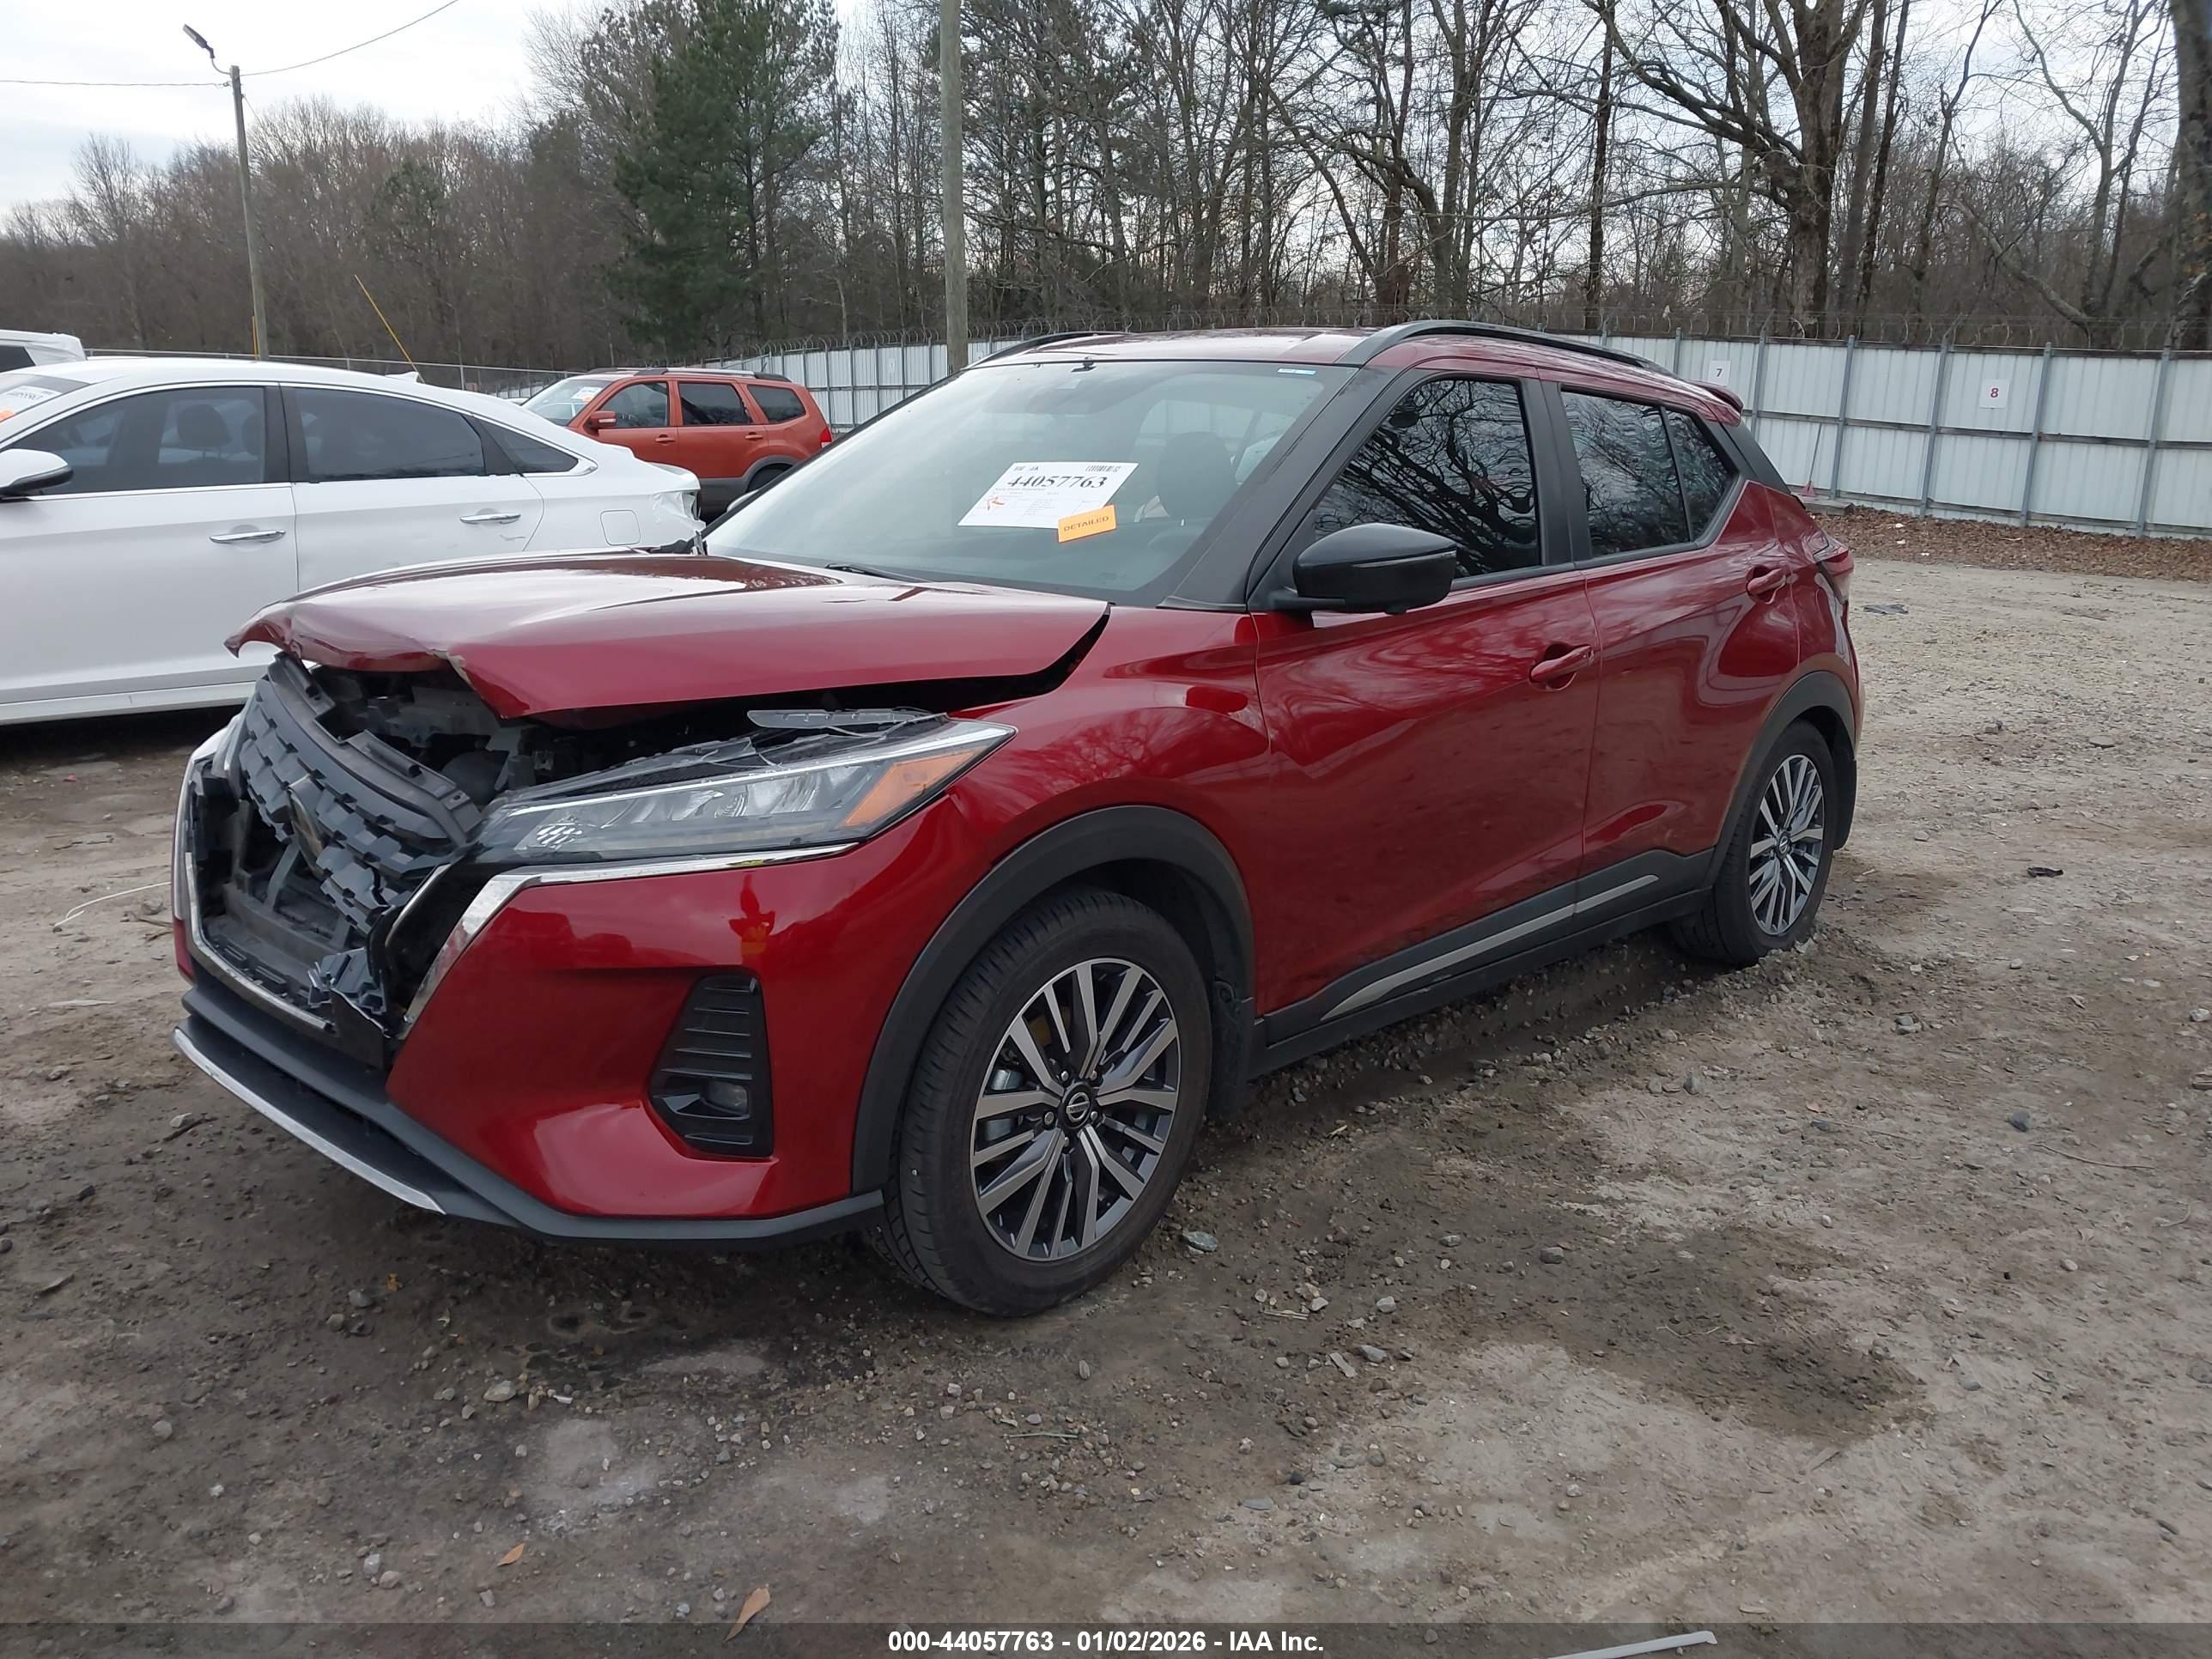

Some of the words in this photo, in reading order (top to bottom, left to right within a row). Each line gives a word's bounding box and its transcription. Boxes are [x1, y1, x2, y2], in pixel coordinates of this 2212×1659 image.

[1717, 368, 1723, 377] 7
[1990, 387, 1999, 398] 8
[1007, 475, 1108, 489] 44057763
[1063, 515, 1109, 532] DETAILED
